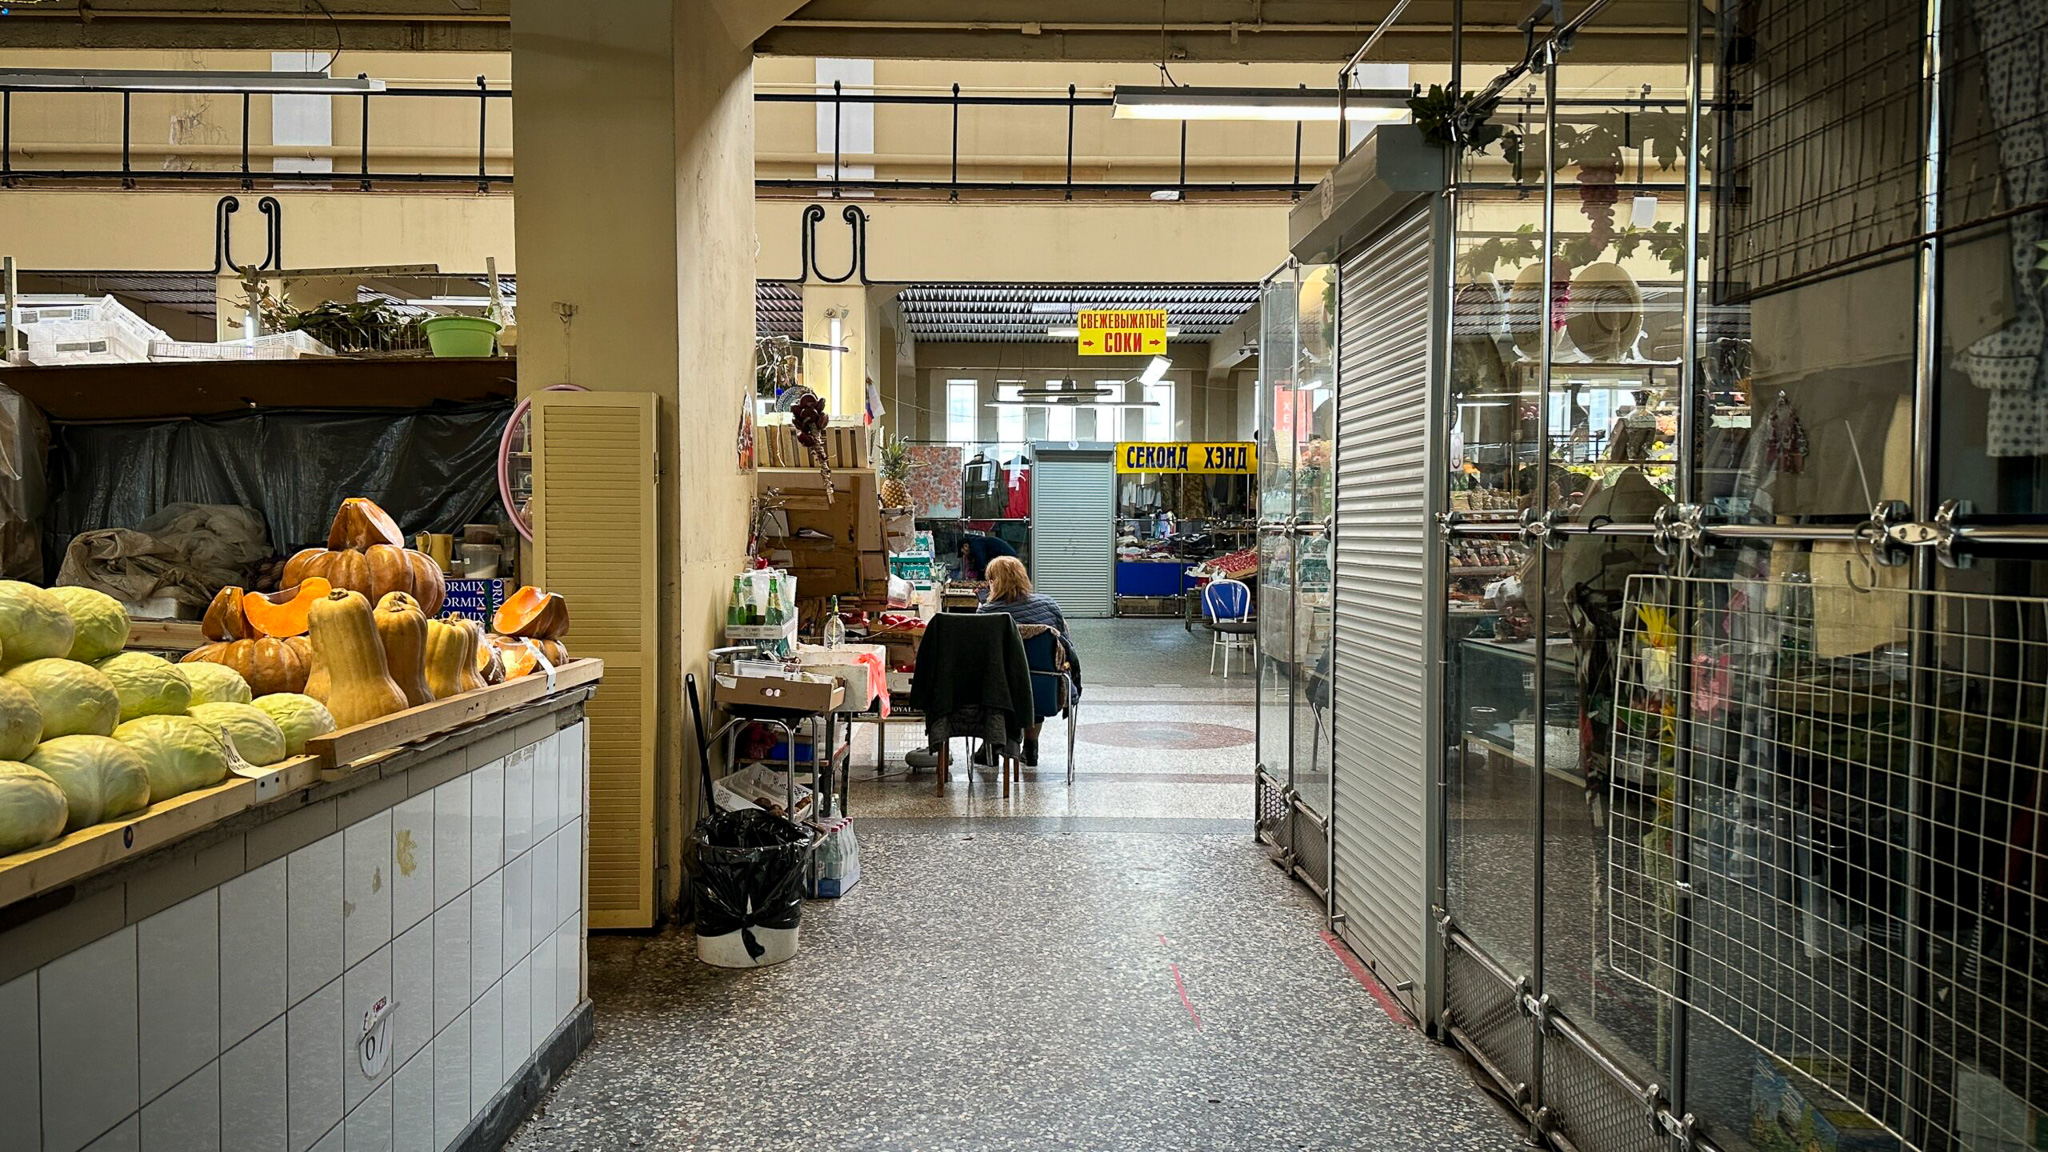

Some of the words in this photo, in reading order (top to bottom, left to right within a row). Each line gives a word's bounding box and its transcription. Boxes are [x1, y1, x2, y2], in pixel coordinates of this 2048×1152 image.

[1080, 313, 1165, 329] СВЕЖЕВЫЖАТЫЕ
[1104, 333, 1142, 353] СОКИ
[1126, 446, 1189, 472] СЕКОНД
[1204, 446, 1248, 472] ХЭНД
[441, 610, 486, 623] OMIX
